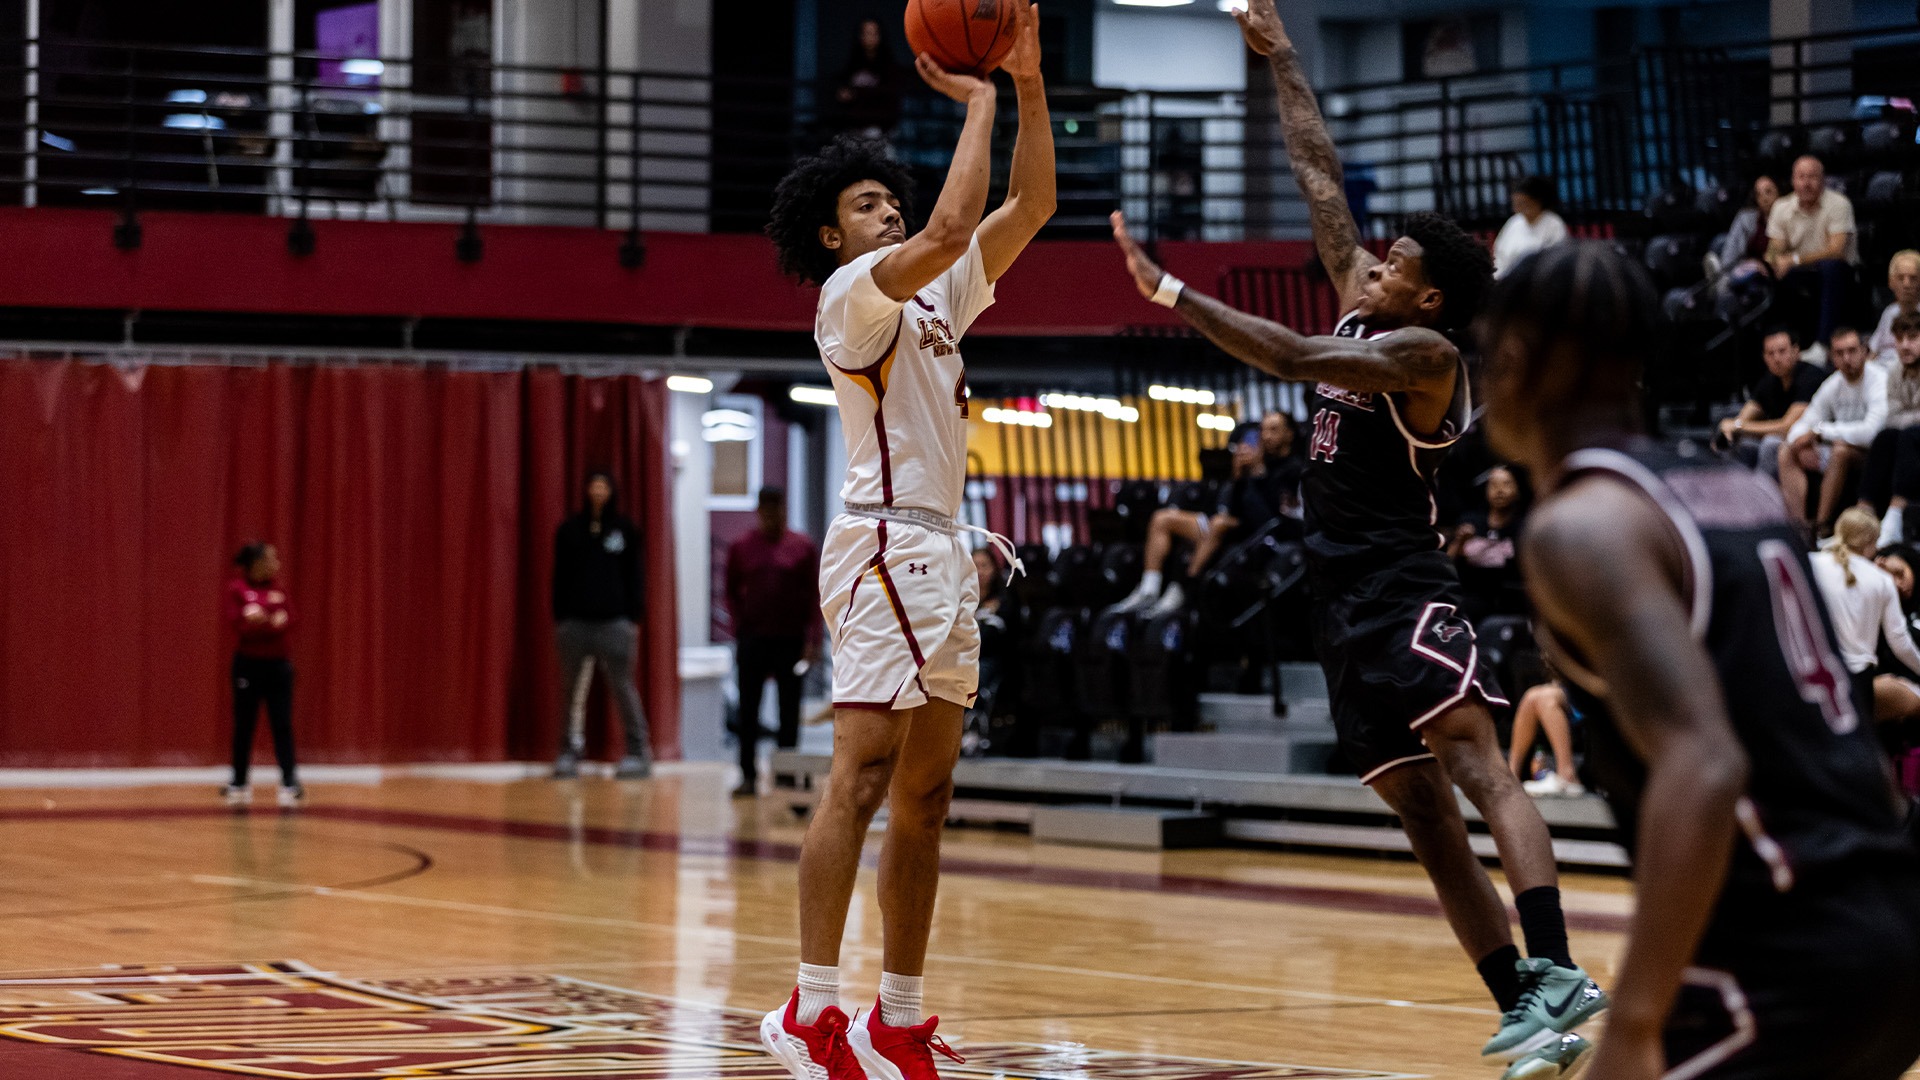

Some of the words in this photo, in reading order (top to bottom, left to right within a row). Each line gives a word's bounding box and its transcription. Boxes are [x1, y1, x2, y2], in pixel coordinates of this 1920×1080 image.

[954, 367, 969, 419] 4
[1310, 407, 1341, 463] 14
[1756, 538, 1858, 736] 4
